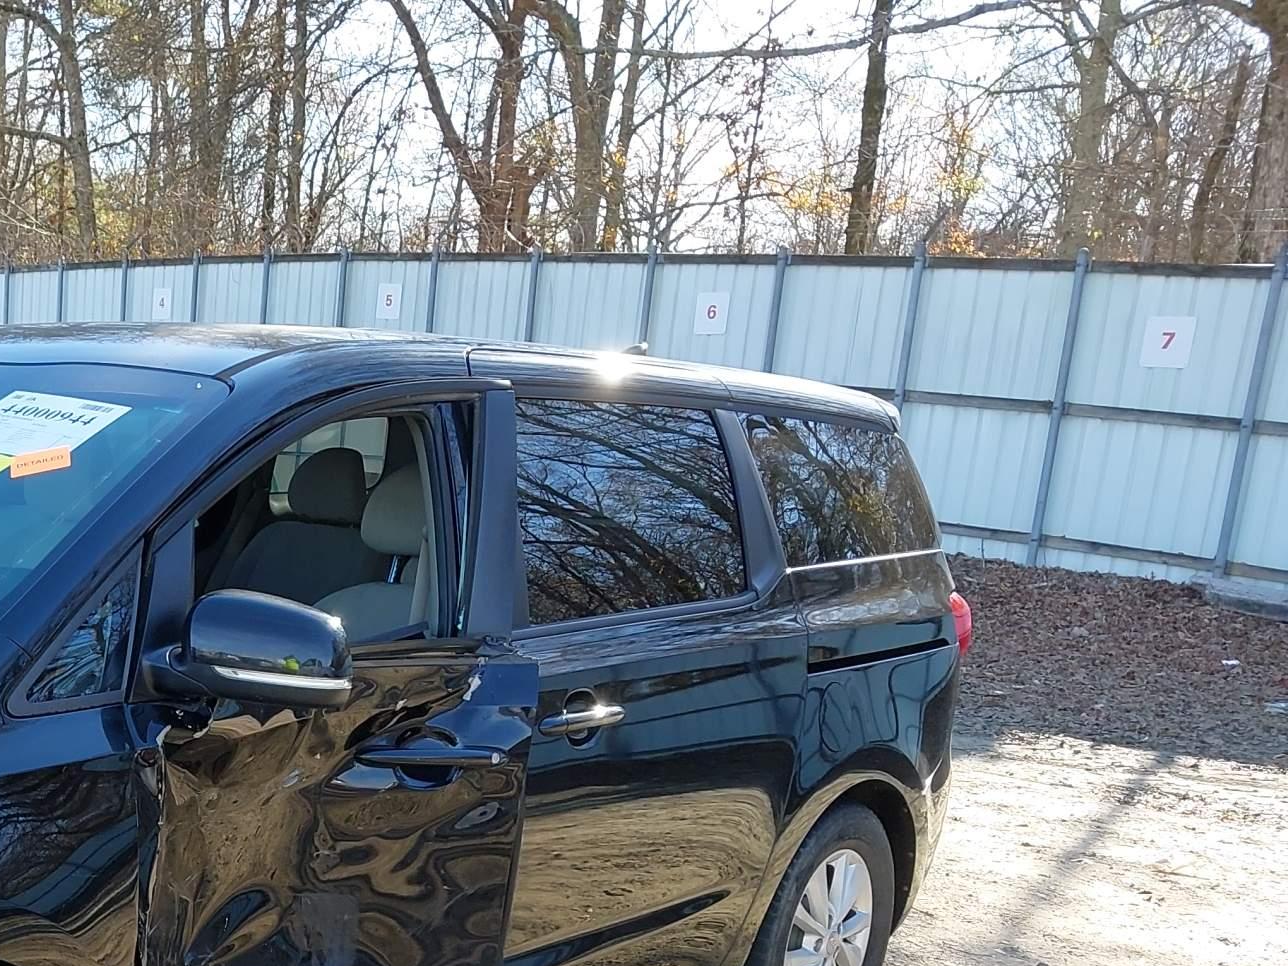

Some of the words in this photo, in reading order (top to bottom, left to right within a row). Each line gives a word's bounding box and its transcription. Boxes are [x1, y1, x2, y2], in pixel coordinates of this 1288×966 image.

[158, 297, 165, 308] 4
[385, 294, 393, 307] 5
[706, 304, 717, 319] 6
[1161, 332, 1177, 350] 7
[0, 403, 98, 426] 44000944
[16, 454, 64, 469] DETAILED
